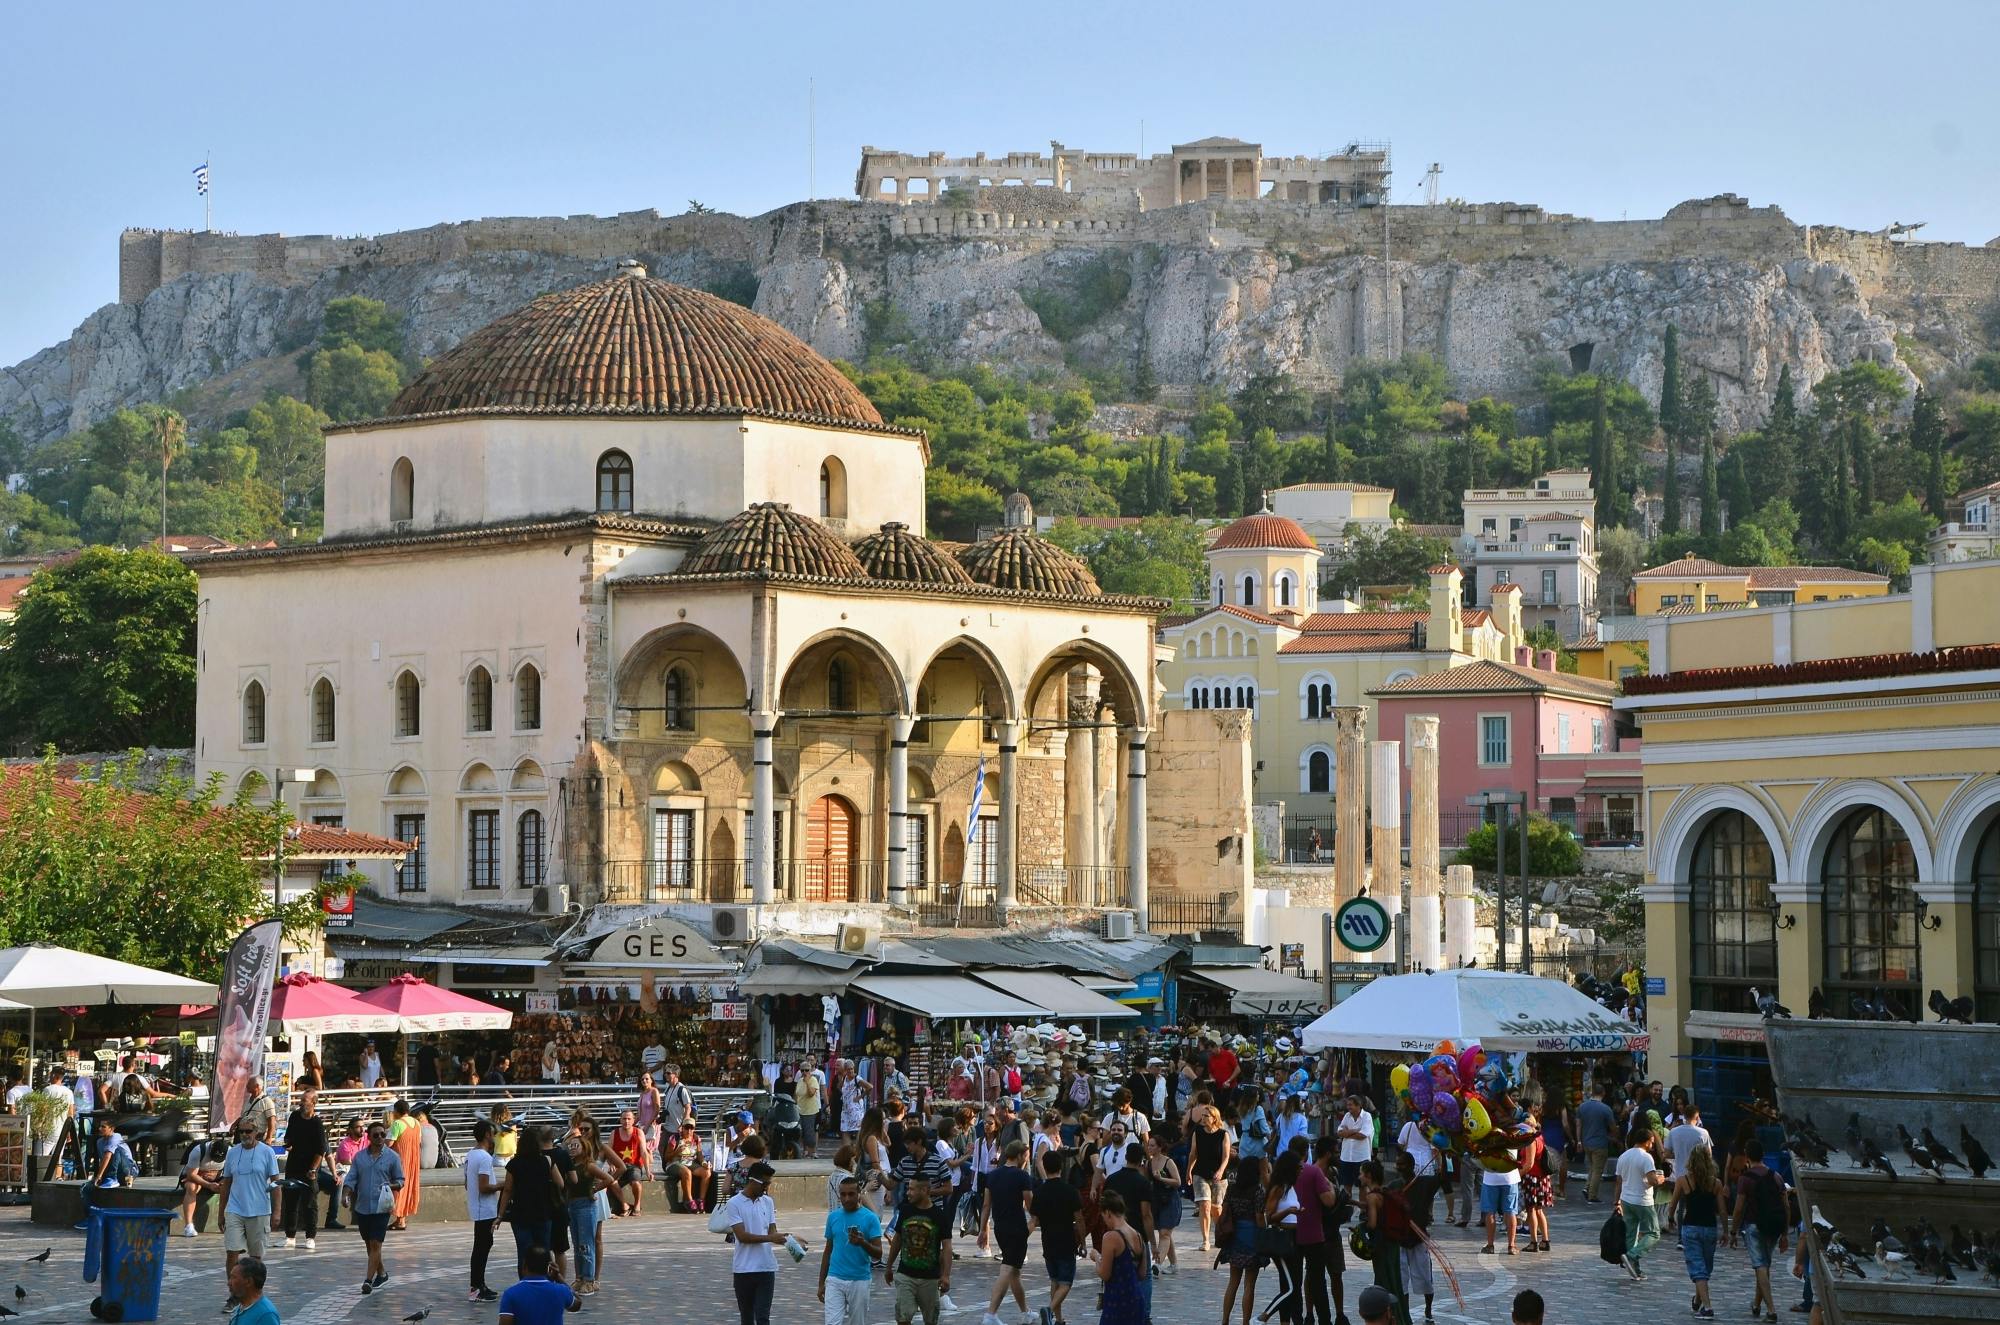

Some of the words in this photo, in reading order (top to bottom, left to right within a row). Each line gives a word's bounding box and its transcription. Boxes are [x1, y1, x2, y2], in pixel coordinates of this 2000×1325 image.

[241, 943, 260, 965] ice
[624, 934, 687, 957] GES
[231, 964, 254, 996] Soft
[361, 965, 381, 978] old
